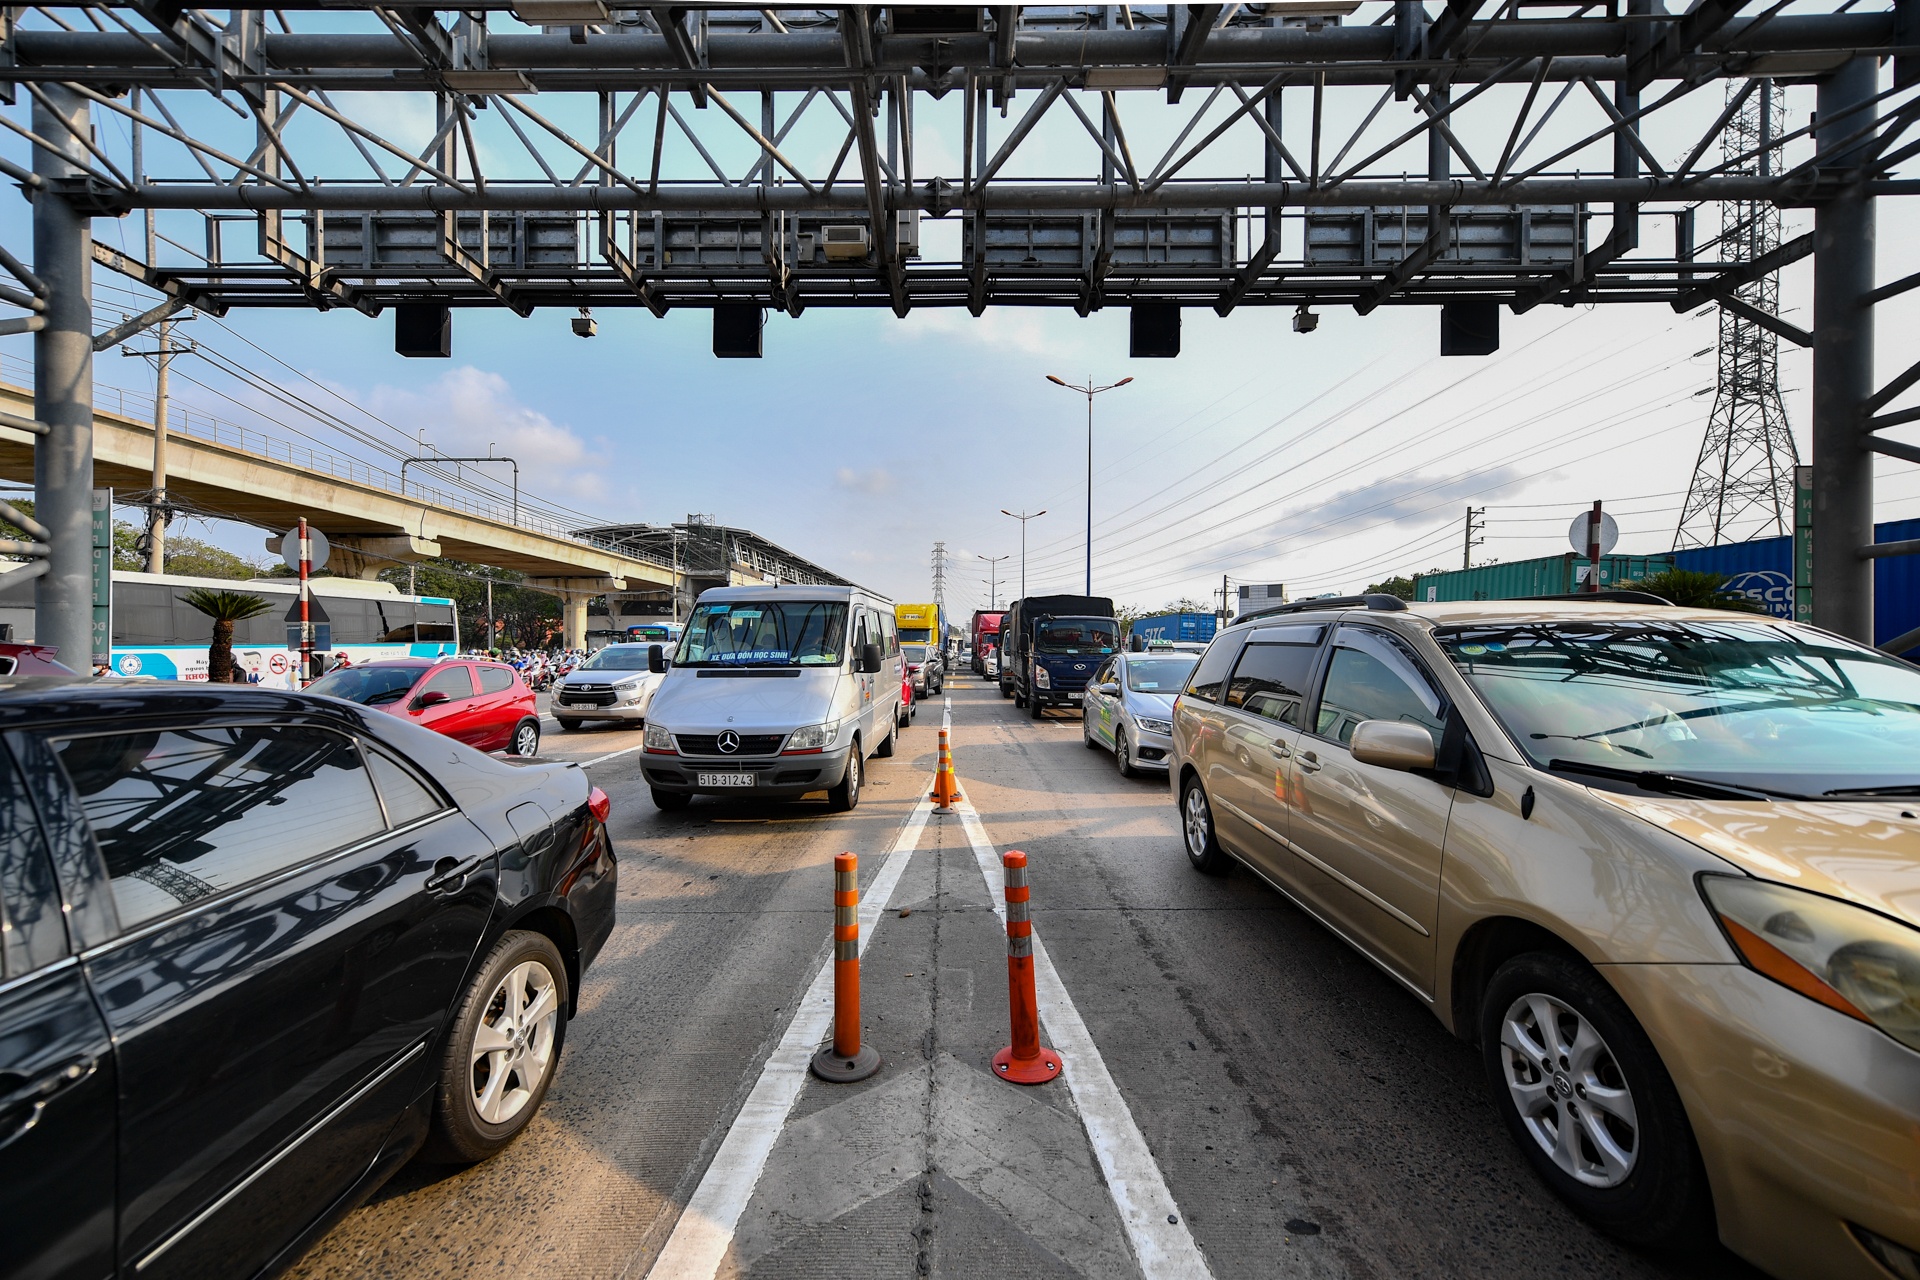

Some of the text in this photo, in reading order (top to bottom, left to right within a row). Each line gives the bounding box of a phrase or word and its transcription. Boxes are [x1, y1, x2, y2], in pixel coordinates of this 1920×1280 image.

[1143, 627, 1165, 642] SITC
[753, 651, 768, 660] HỌC
[769, 651, 788, 659] SINH
[700, 774, 753, 786] 51B-312.43
